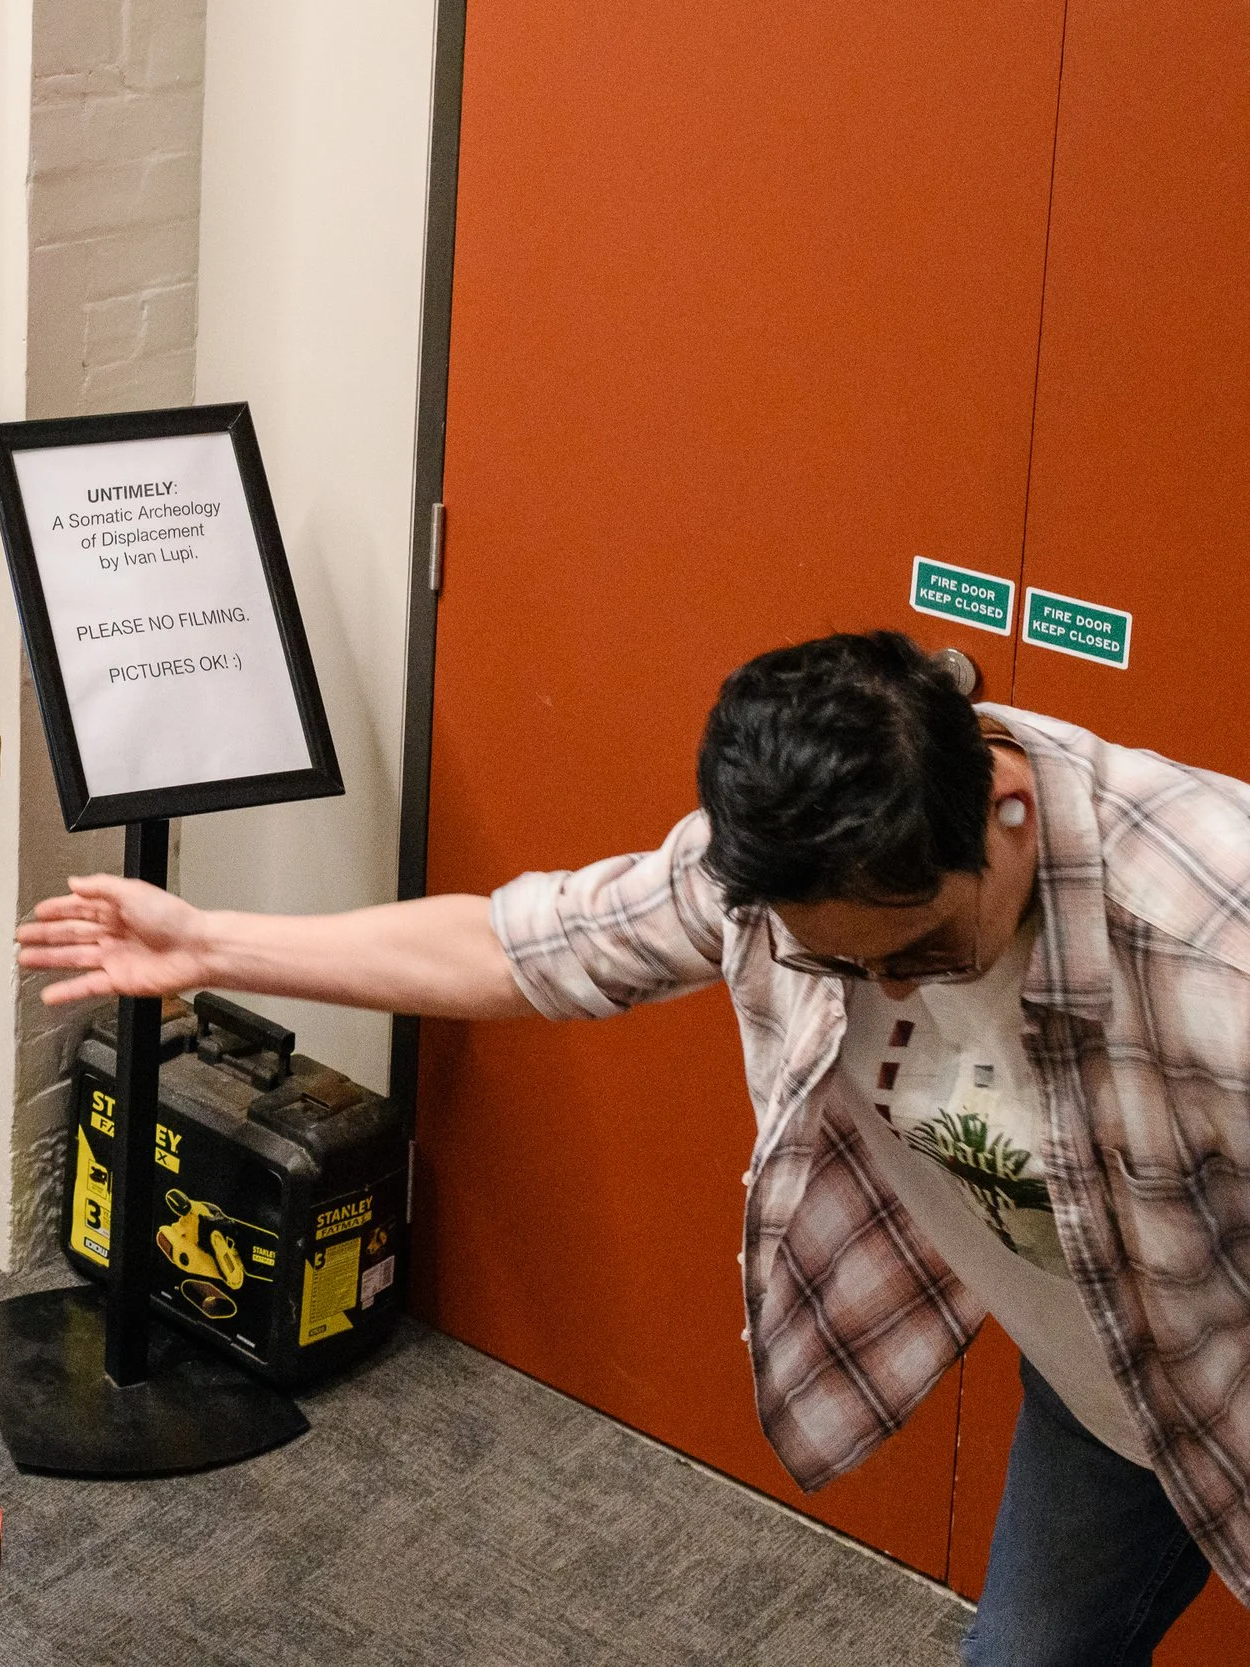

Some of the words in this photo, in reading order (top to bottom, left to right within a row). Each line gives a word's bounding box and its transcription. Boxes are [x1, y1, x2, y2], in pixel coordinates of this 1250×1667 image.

[87, 481, 178, 504] UNTIMELY:
[52, 516, 64, 531] A
[69, 508, 134, 529] Somatic
[138, 501, 221, 520] Archeology
[81, 533, 97, 549] of
[102, 523, 205, 548] Displacement
[99, 554, 119, 572] by
[124, 549, 157, 566] Ivan
[161, 546, 199, 565] Lupi.
[931, 575, 957, 591] FIRE
[962, 583, 995, 601] DOOR
[920, 588, 951, 604] KEEP
[955, 598, 1003, 619] CLOSED
[76, 618, 145, 641] PLEASE
[149, 614, 175, 632] NO
[179, 607, 249, 629] FILMING.
[1043, 607, 1072, 623] FIRE
[1076, 616, 1111, 634] DOOR
[1033, 620, 1065, 637] KEEP
[1069, 630, 1120, 652] CLOSED
[109, 658, 196, 683] PICTURES
[199, 654, 229, 673] OK!
[87, 1199, 101, 1230] 3
[317, 1195, 373, 1228] STANLEY
